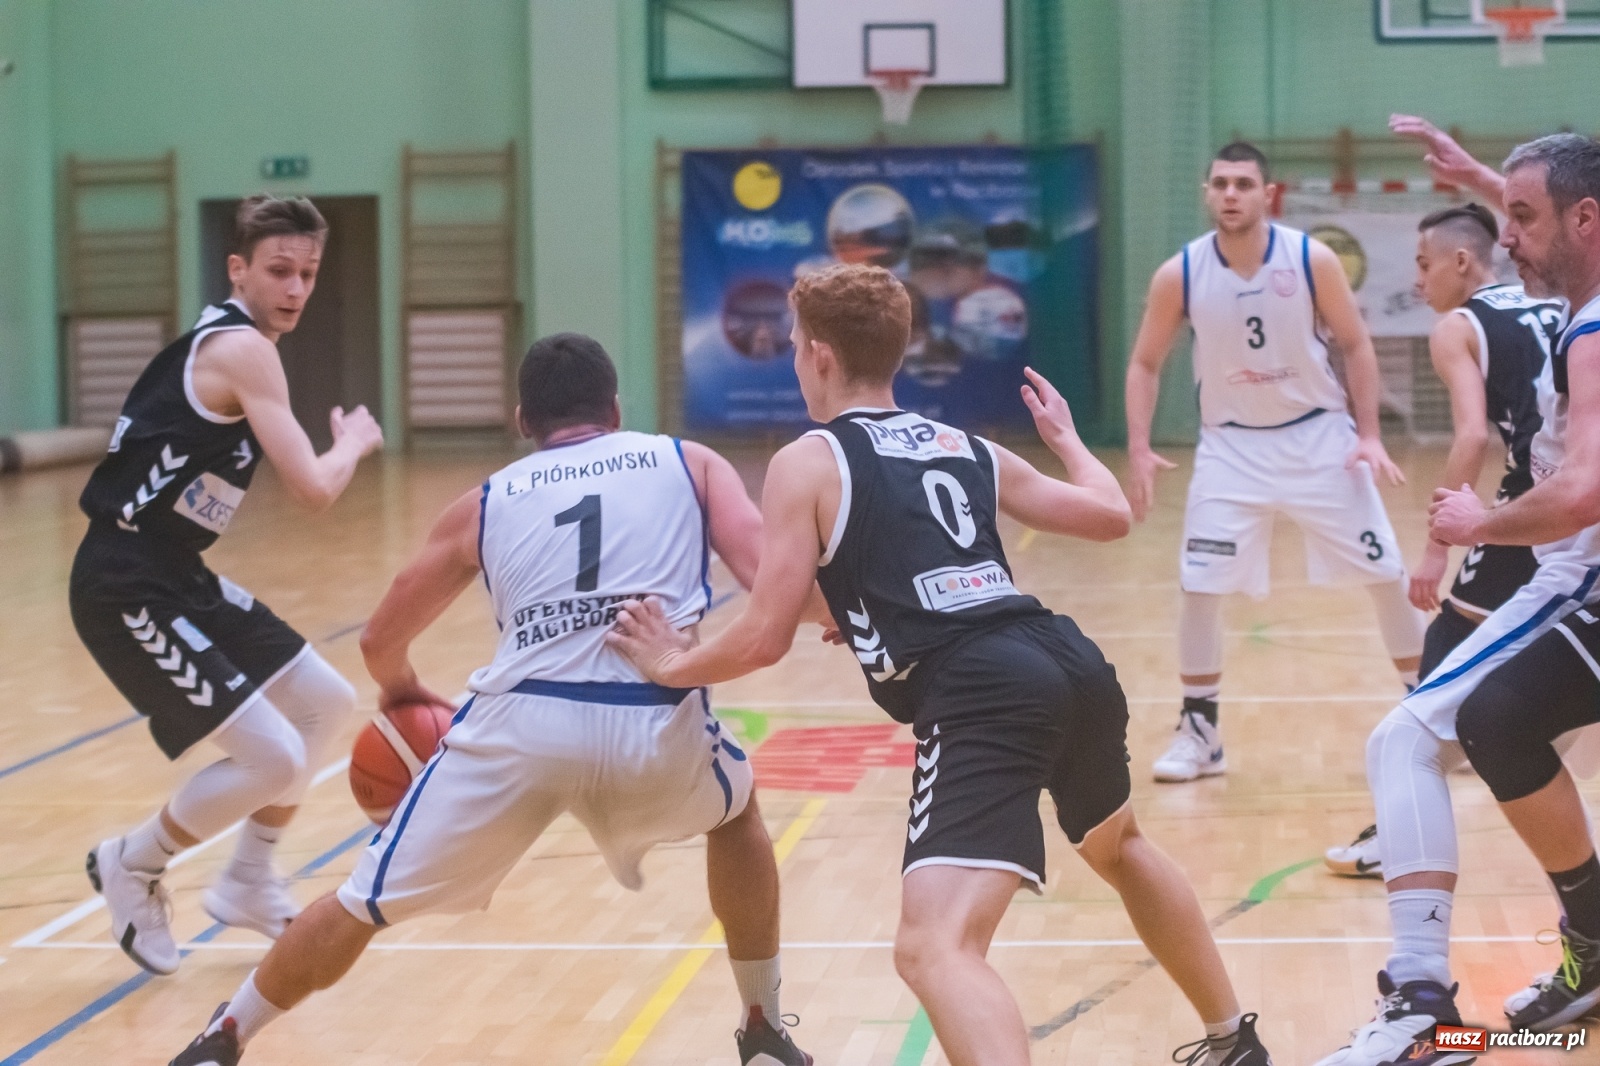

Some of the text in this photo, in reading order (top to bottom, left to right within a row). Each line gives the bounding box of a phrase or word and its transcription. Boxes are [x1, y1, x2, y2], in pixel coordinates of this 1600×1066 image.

[1246, 316, 1266, 350] 3
[861, 422, 937, 451] piga
[506, 450, 658, 496] Ł. PIÓRKOWSKI
[922, 469, 977, 549] 0
[554, 493, 602, 593] 1
[1359, 530, 1384, 562] 3
[516, 606, 624, 651] RACIBOR
